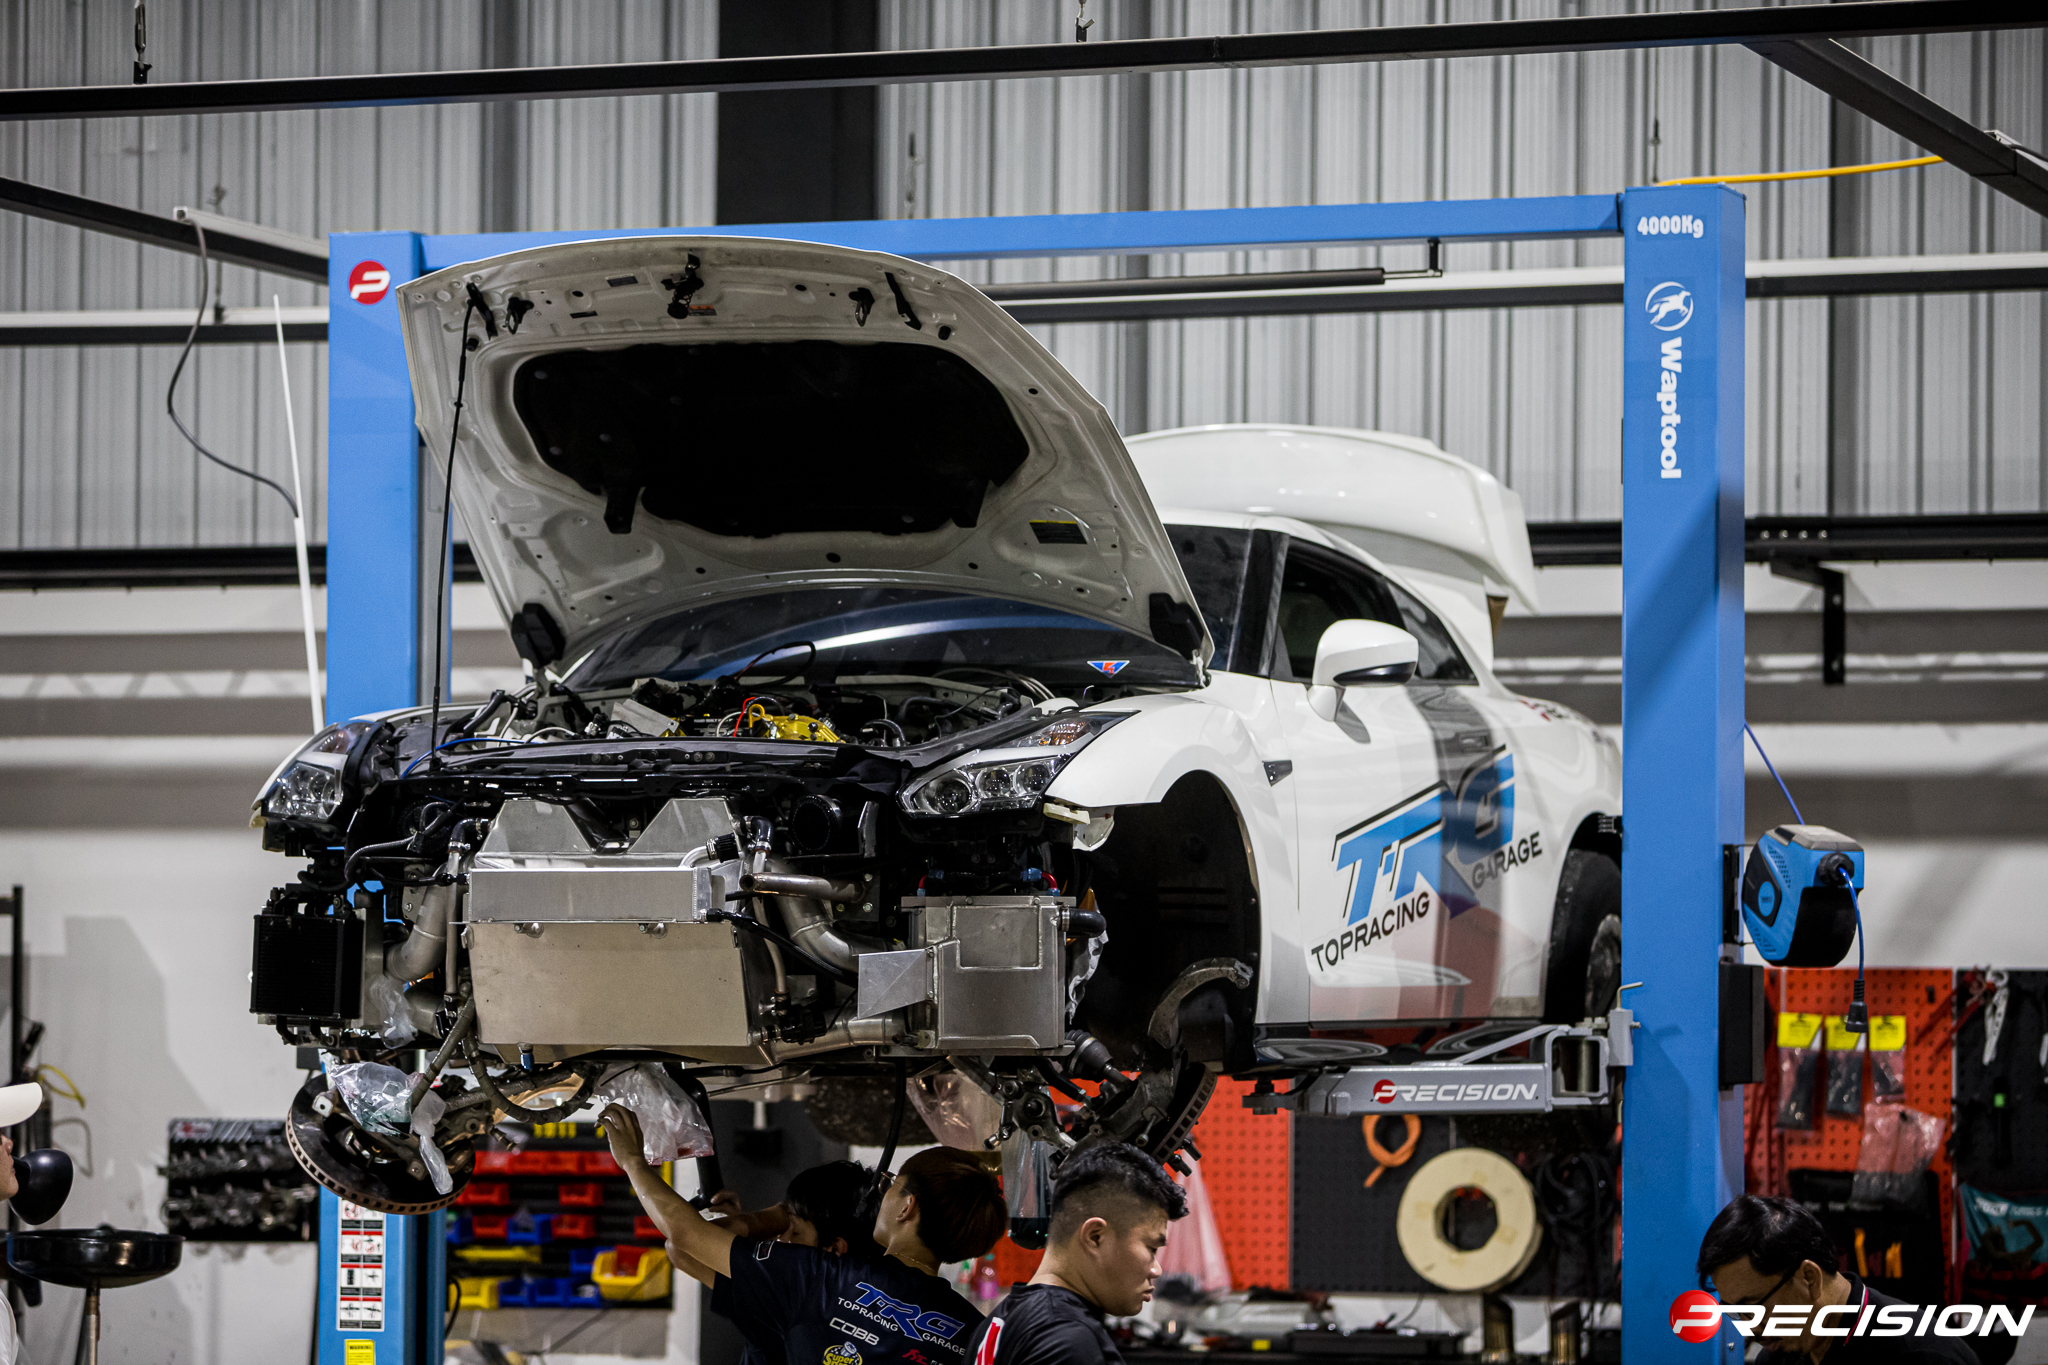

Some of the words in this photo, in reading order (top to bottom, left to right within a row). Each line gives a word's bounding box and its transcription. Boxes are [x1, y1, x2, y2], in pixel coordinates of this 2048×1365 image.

[1637, 215, 1704, 238] 4000Kg
[1656, 336, 1682, 479] Waptool
[1472, 831, 1543, 889] GARAGE
[1311, 891, 1430, 972] TOPRACING
[1374, 1083, 1538, 1102] PRECISION
[837, 1296, 899, 1332] TOPRACING
[829, 1317, 880, 1346] COBB
[922, 1332, 967, 1356] GARAGE
